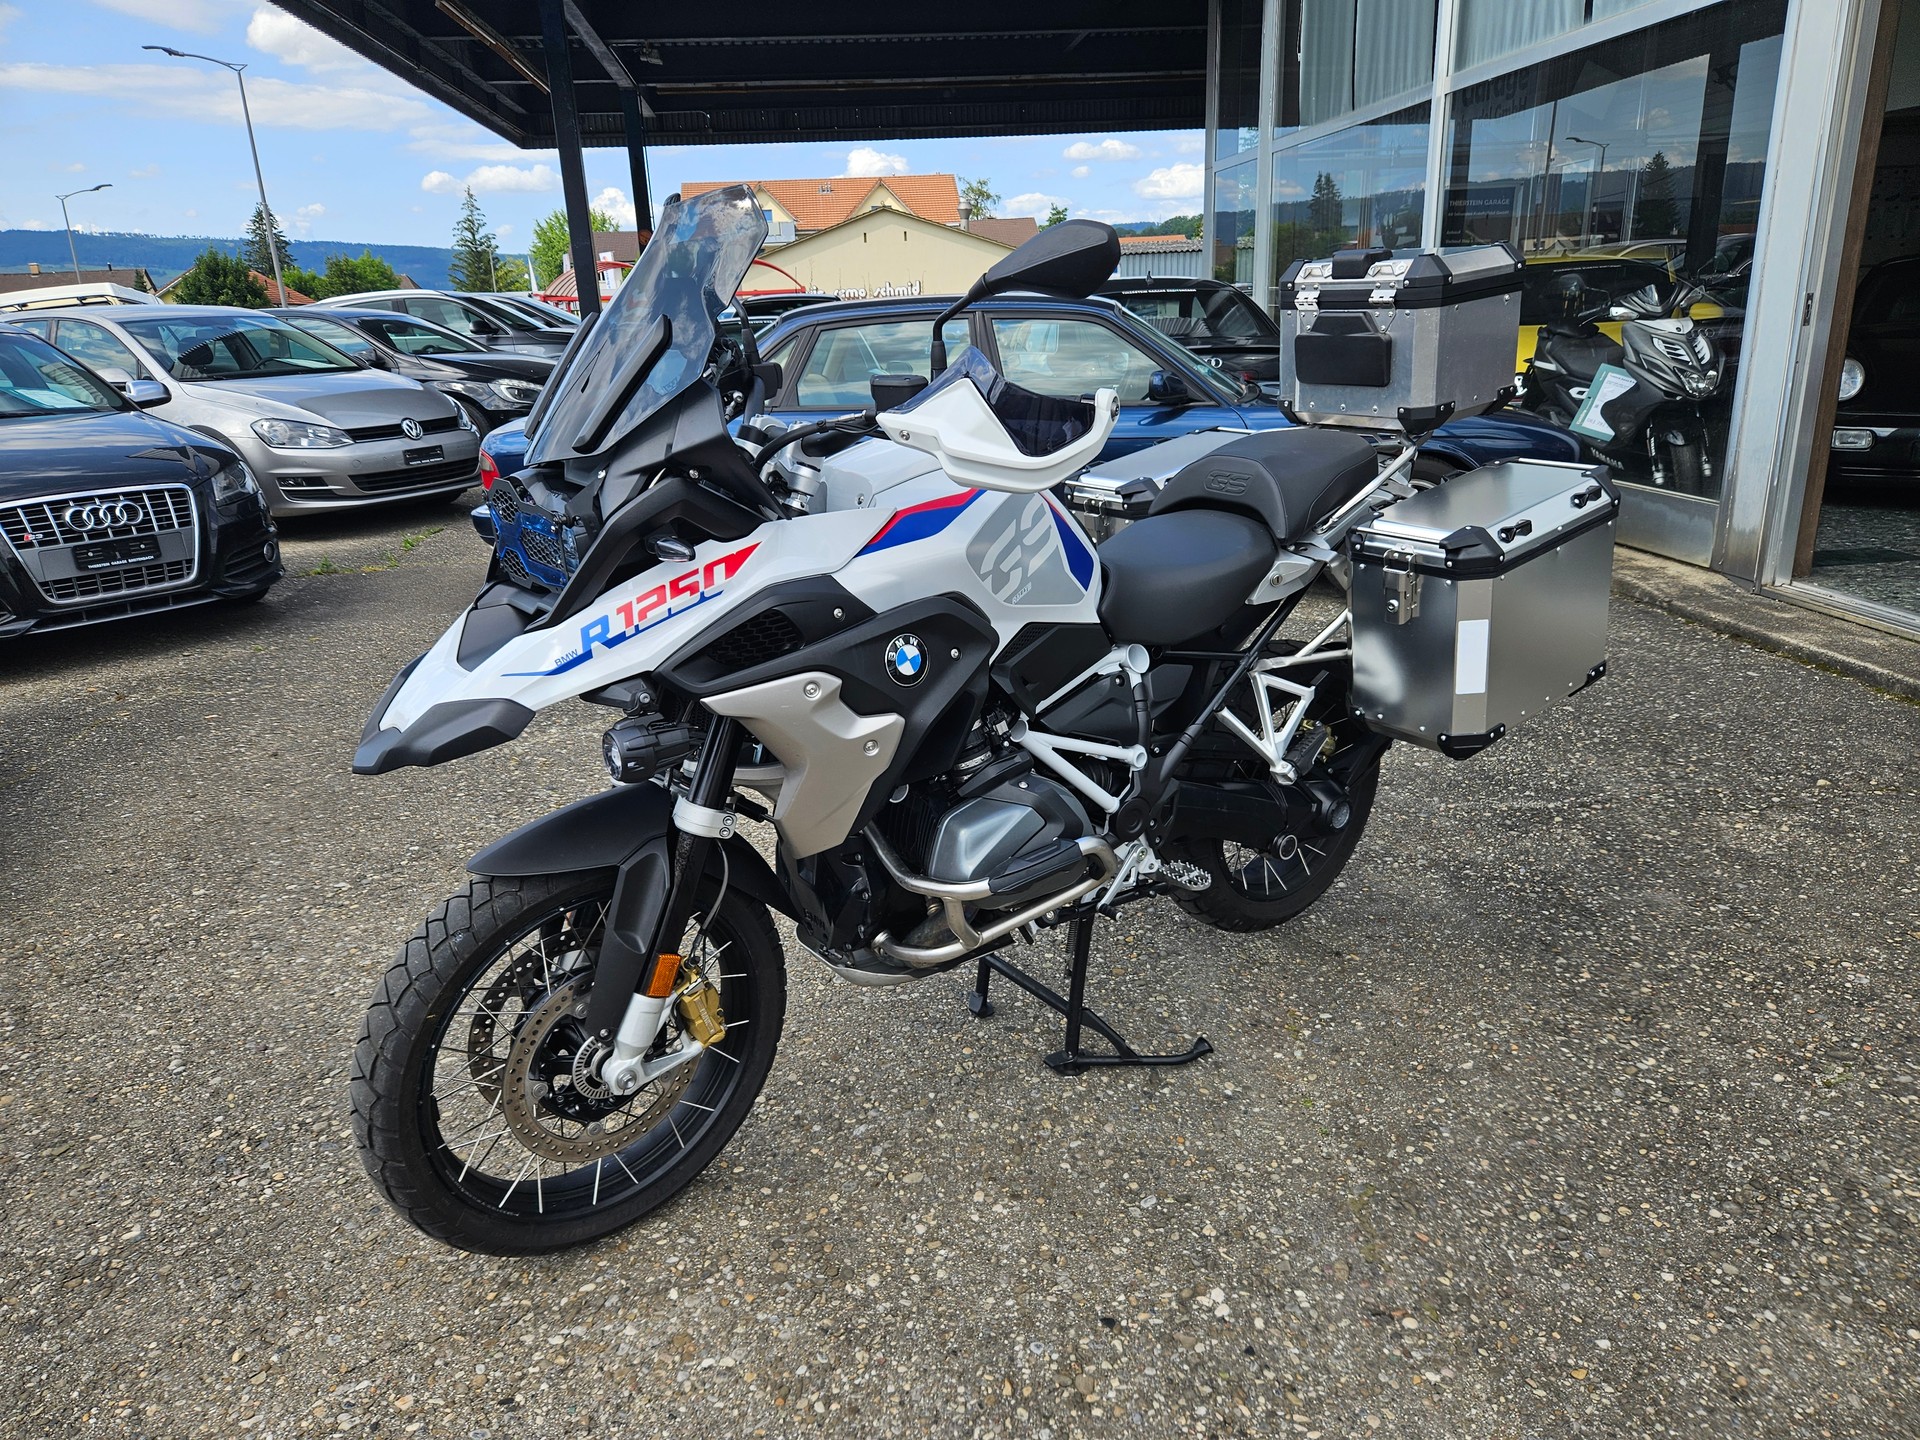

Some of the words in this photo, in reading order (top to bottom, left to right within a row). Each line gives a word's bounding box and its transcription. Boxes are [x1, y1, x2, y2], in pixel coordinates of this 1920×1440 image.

[873, 280, 922, 298] schmid
[1590, 447, 1624, 470] YAMAHA
[554, 648, 579, 667] BMW
[888, 636, 919, 661] BMW
